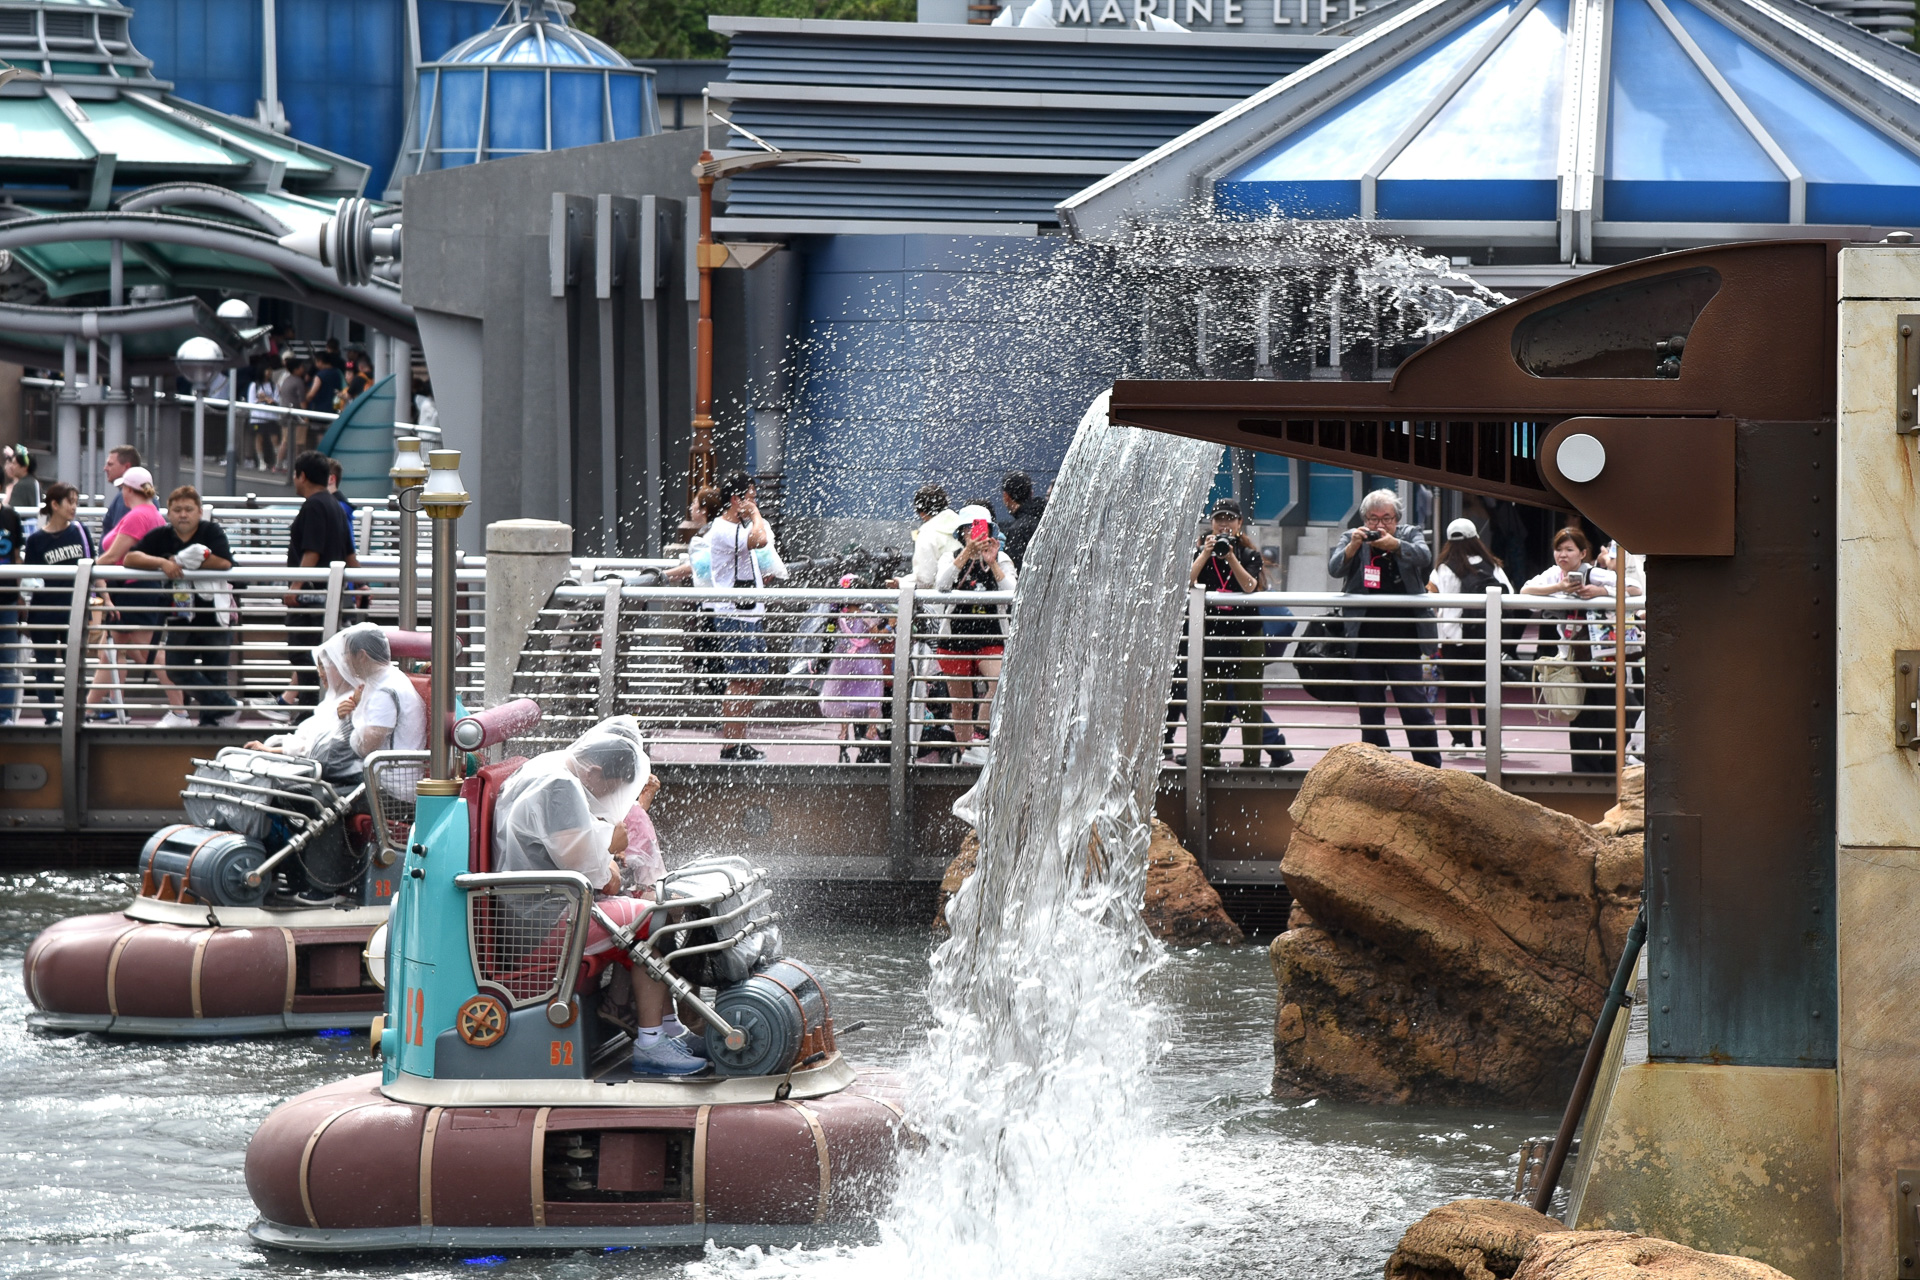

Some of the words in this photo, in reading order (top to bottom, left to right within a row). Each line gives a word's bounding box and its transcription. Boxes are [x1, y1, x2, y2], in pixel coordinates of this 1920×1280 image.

[1060, 0, 1244, 24] MARINE
[44, 544, 84, 565] CHARTRES
[405, 987, 425, 1047] 52
[550, 1040, 573, 1066] 52
